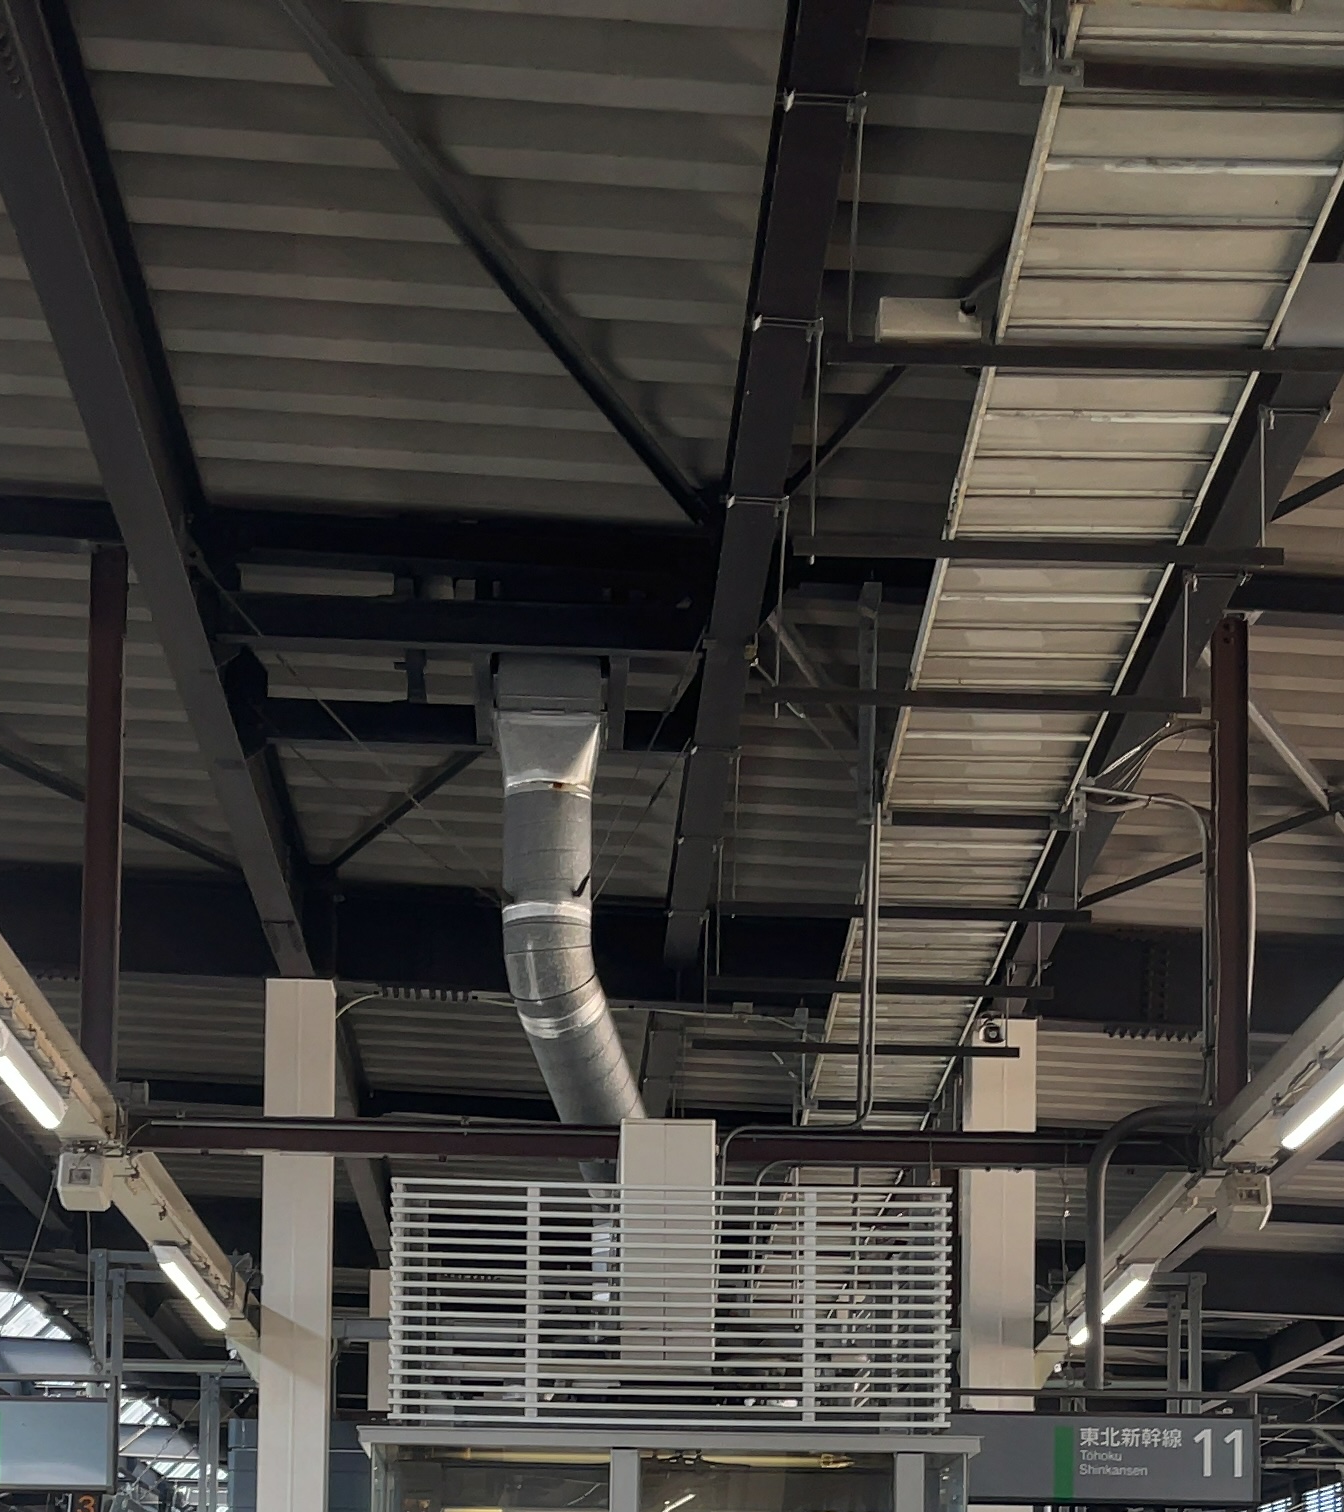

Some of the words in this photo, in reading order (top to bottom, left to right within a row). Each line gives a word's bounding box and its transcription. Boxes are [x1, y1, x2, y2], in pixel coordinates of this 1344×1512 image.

[1079, 1427, 1182, 1448] 東北新幹線
[1193, 1428, 1243, 1478] 11
[1079, 1463, 1148, 1476] Shinkansen
